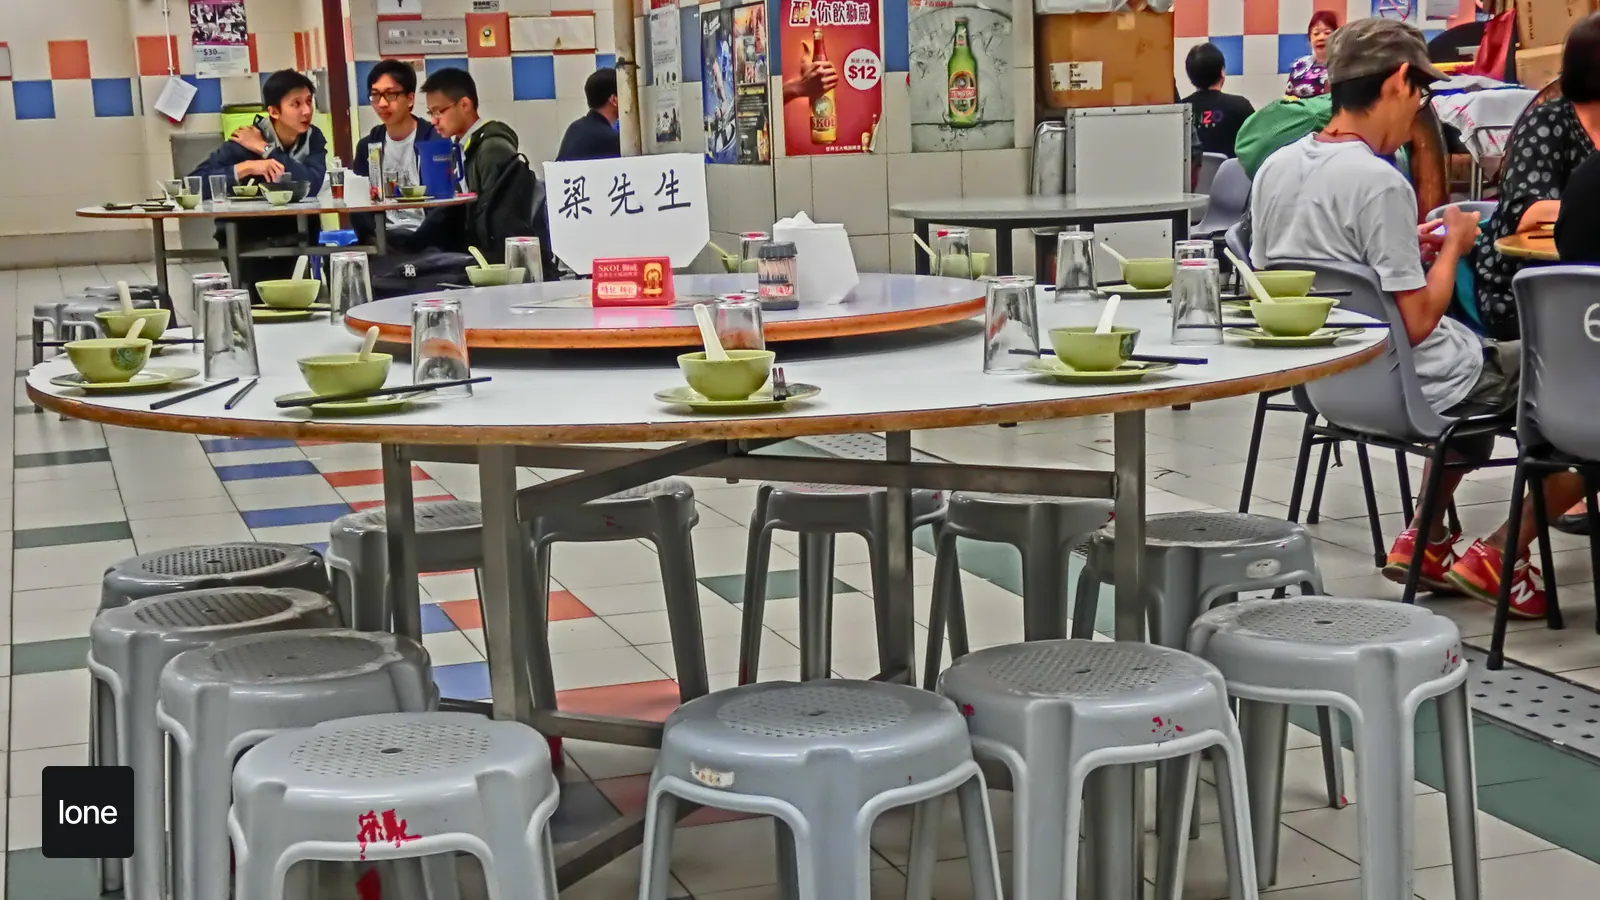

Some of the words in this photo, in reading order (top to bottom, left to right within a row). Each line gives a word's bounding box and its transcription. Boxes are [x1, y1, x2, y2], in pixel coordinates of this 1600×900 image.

[203, 48, 218, 56] $30
[848, 64, 877, 81] $12
[558, 169, 692, 219] 梁先生
[598, 264, 621, 272] SKOL
